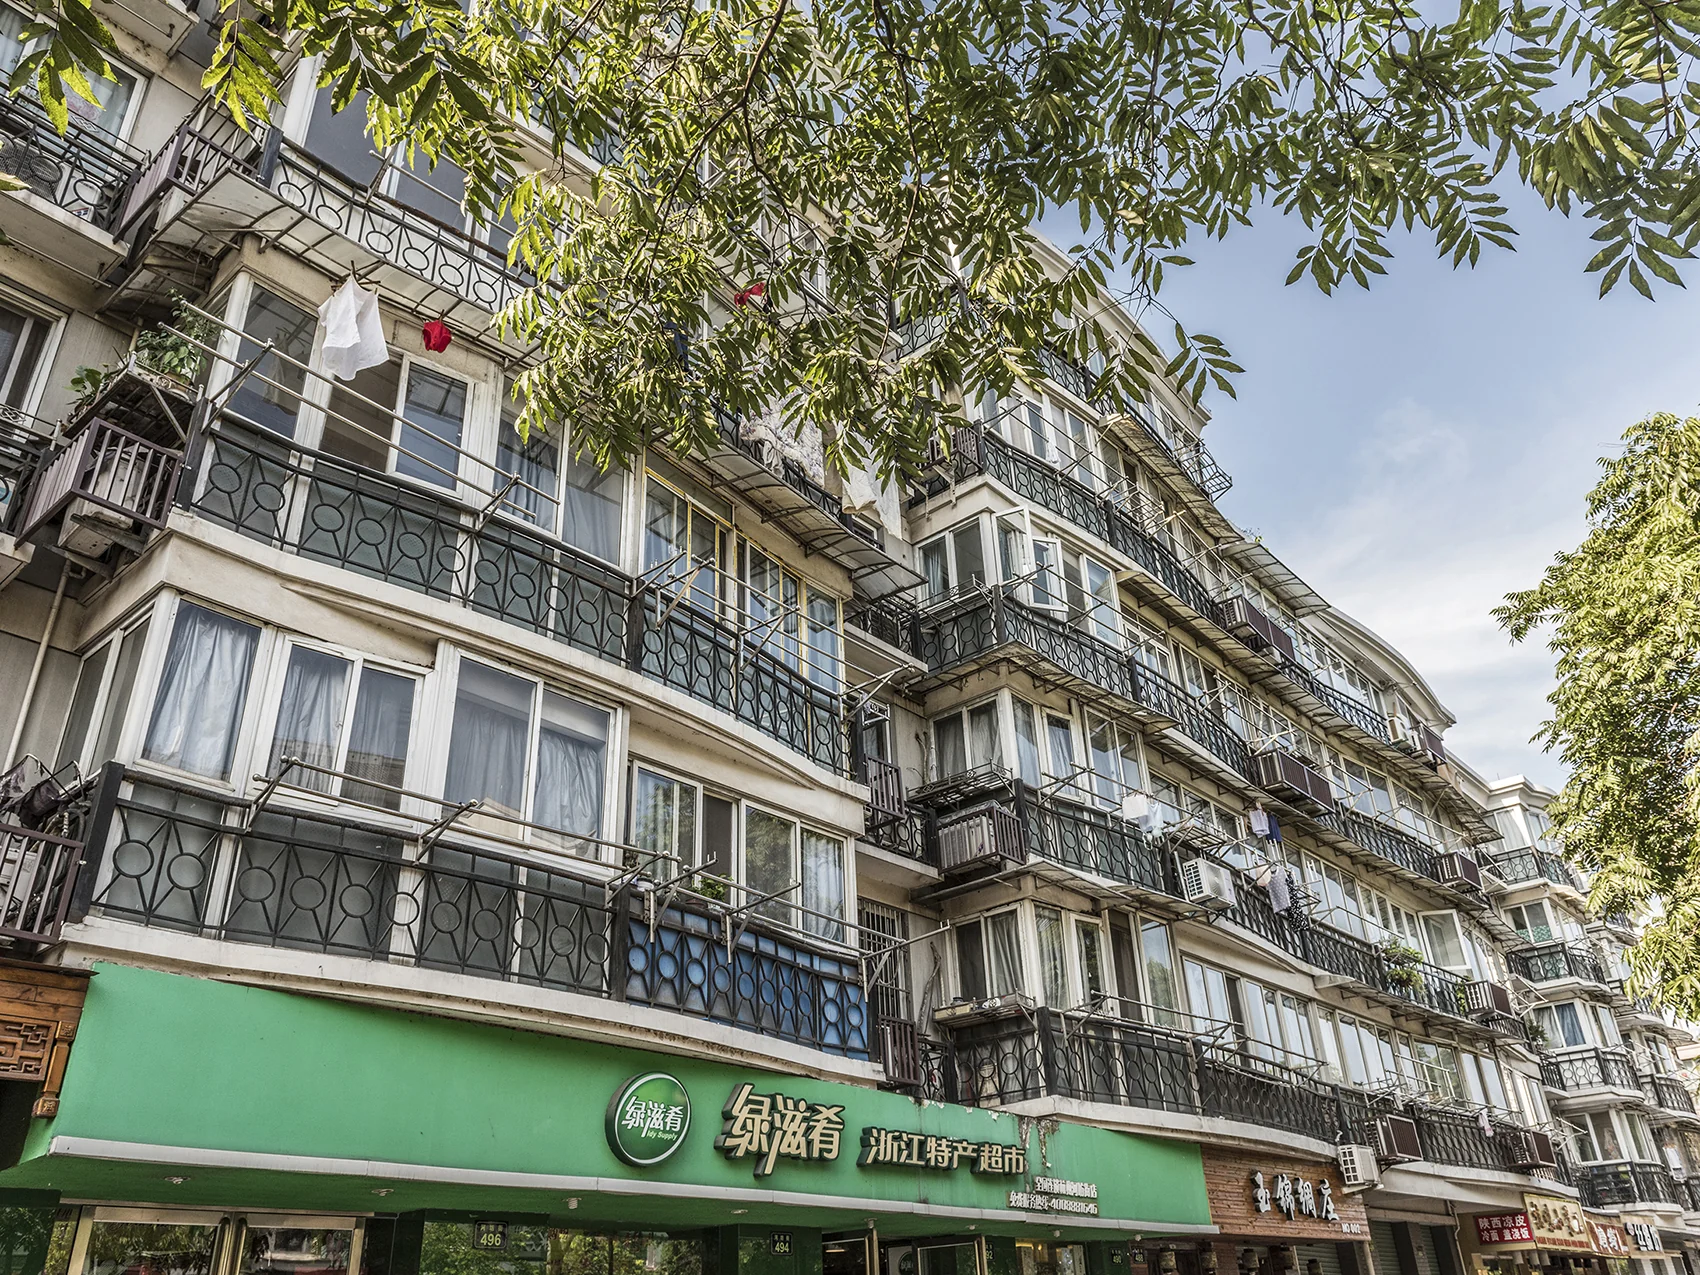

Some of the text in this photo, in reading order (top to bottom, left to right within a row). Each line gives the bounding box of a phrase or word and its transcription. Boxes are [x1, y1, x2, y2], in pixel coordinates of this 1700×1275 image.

[621, 1095, 684, 1138] 绿滋肴
[722, 1083, 845, 1176] 绿滋肴
[866, 1127, 1026, 1174] 浙江特产超市
[1478, 1214, 1527, 1230] 陕西凉皮
[480, 1233, 501, 1246] 496
[1481, 1229, 1500, 1242] 冷面
[775, 1242, 790, 1253] 494
